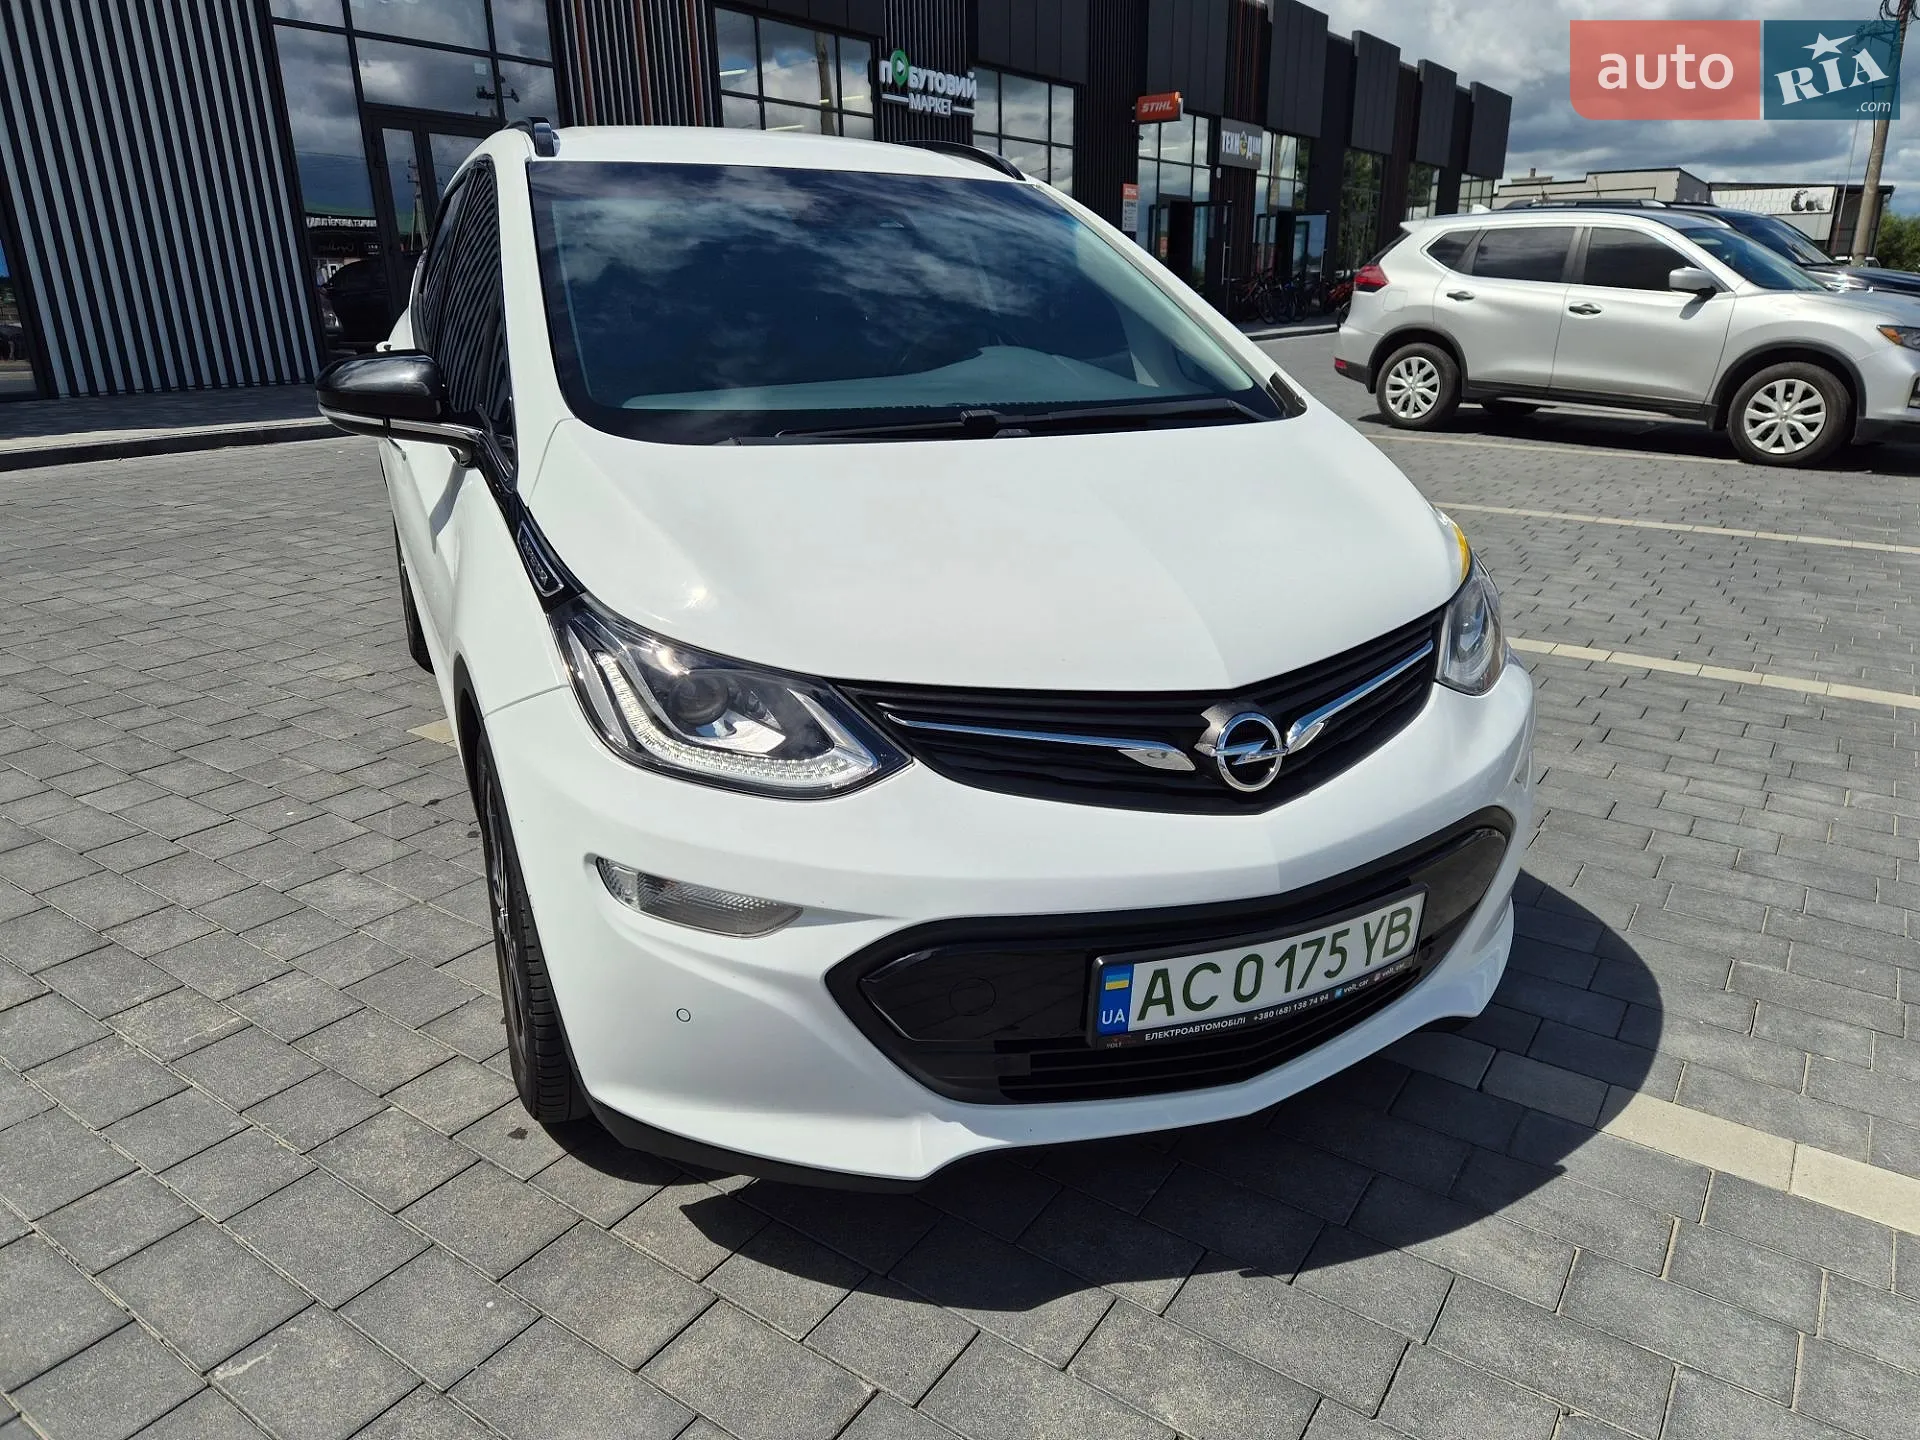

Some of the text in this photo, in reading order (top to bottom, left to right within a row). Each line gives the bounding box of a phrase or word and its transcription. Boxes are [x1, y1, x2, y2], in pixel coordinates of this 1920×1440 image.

[908, 92, 953, 116] МАРКЕТ
[1140, 101, 1173, 113] STIHL
[1136, 906, 1413, 1022] AC 0175 YB
[1101, 1008, 1126, 1025] UA
[1144, 1016, 1246, 1041] ЕЛЕКТРОАВТОМОБІЛІ
[1253, 1010, 1275, 1021] +380
